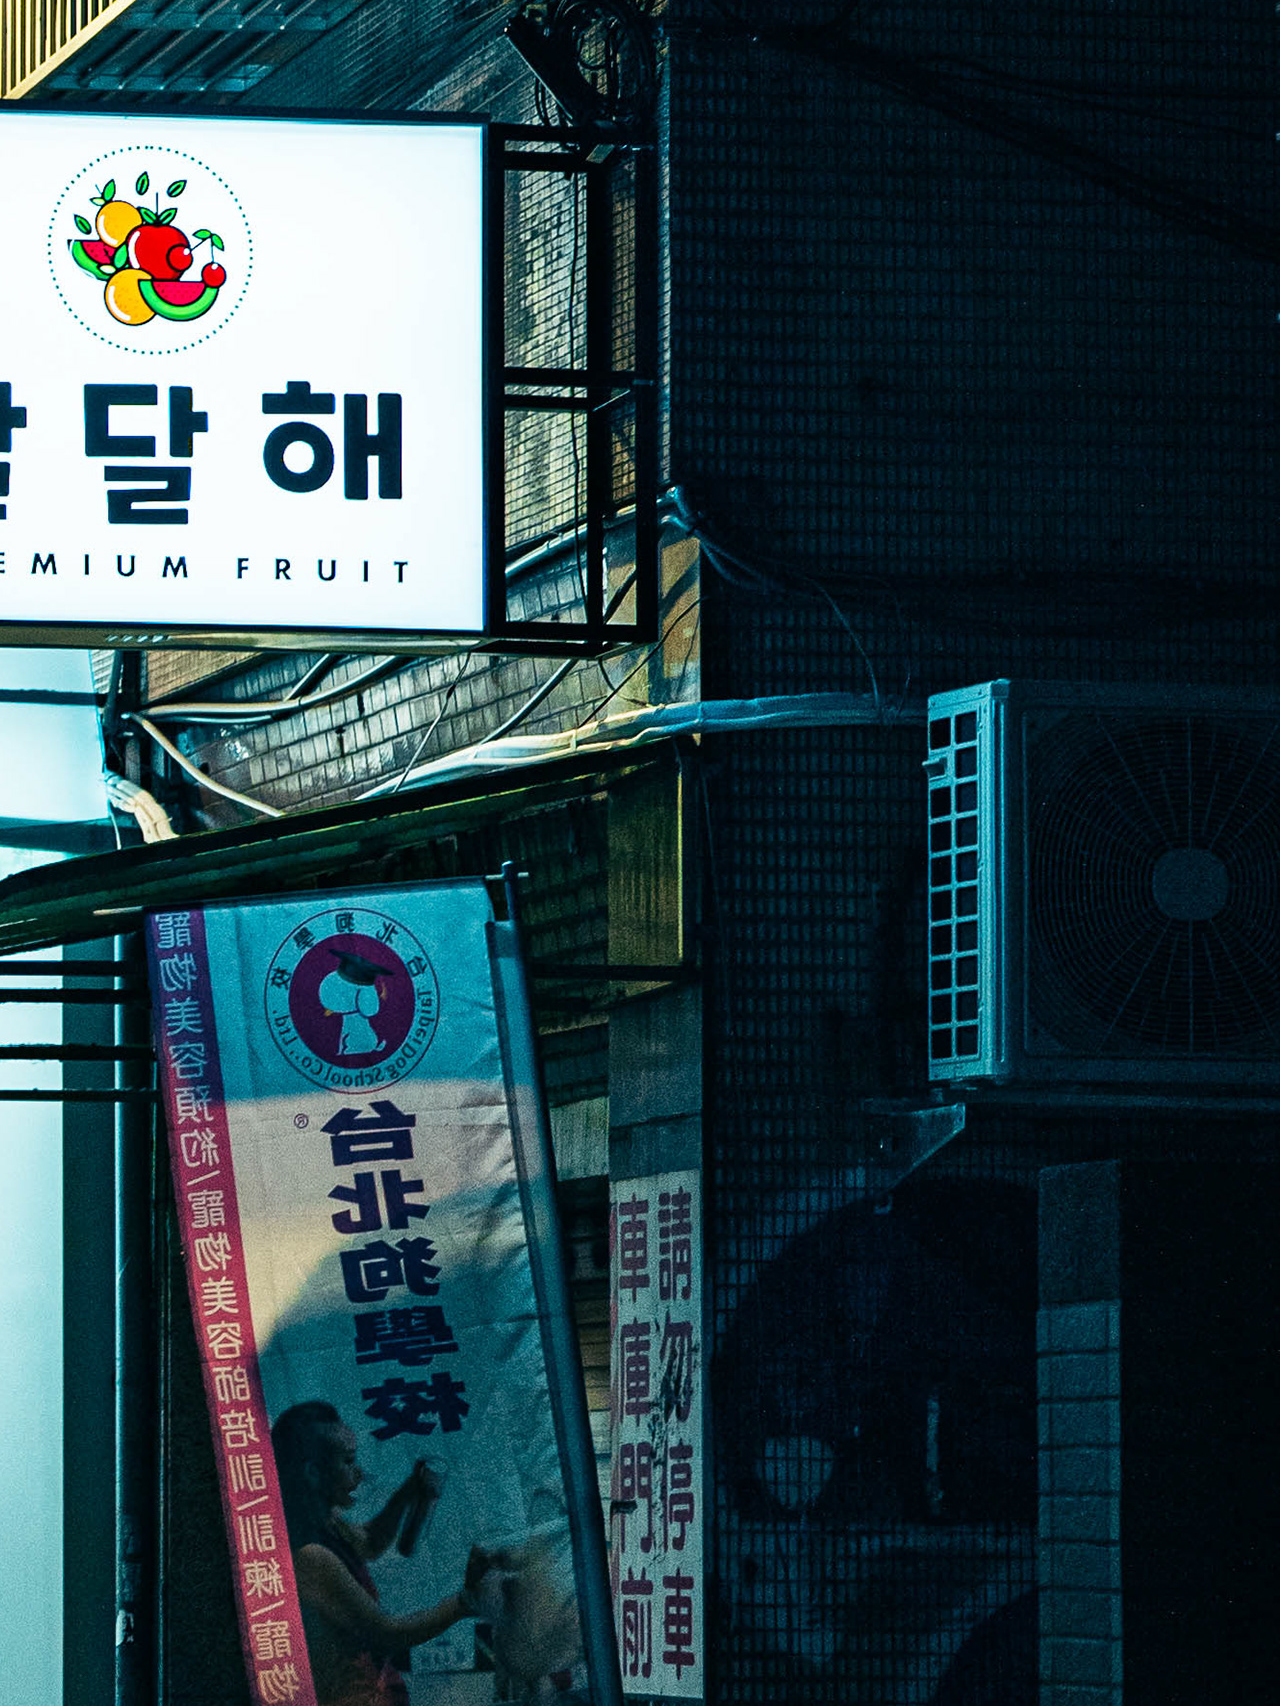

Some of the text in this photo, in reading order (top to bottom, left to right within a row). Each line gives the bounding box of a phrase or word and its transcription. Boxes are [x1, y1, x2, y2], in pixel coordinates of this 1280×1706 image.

[237, 556, 410, 584] FRUIT
[614, 1189, 654, 1681] 車庫門前
[657, 1183, 697, 1681] 請勿停車
